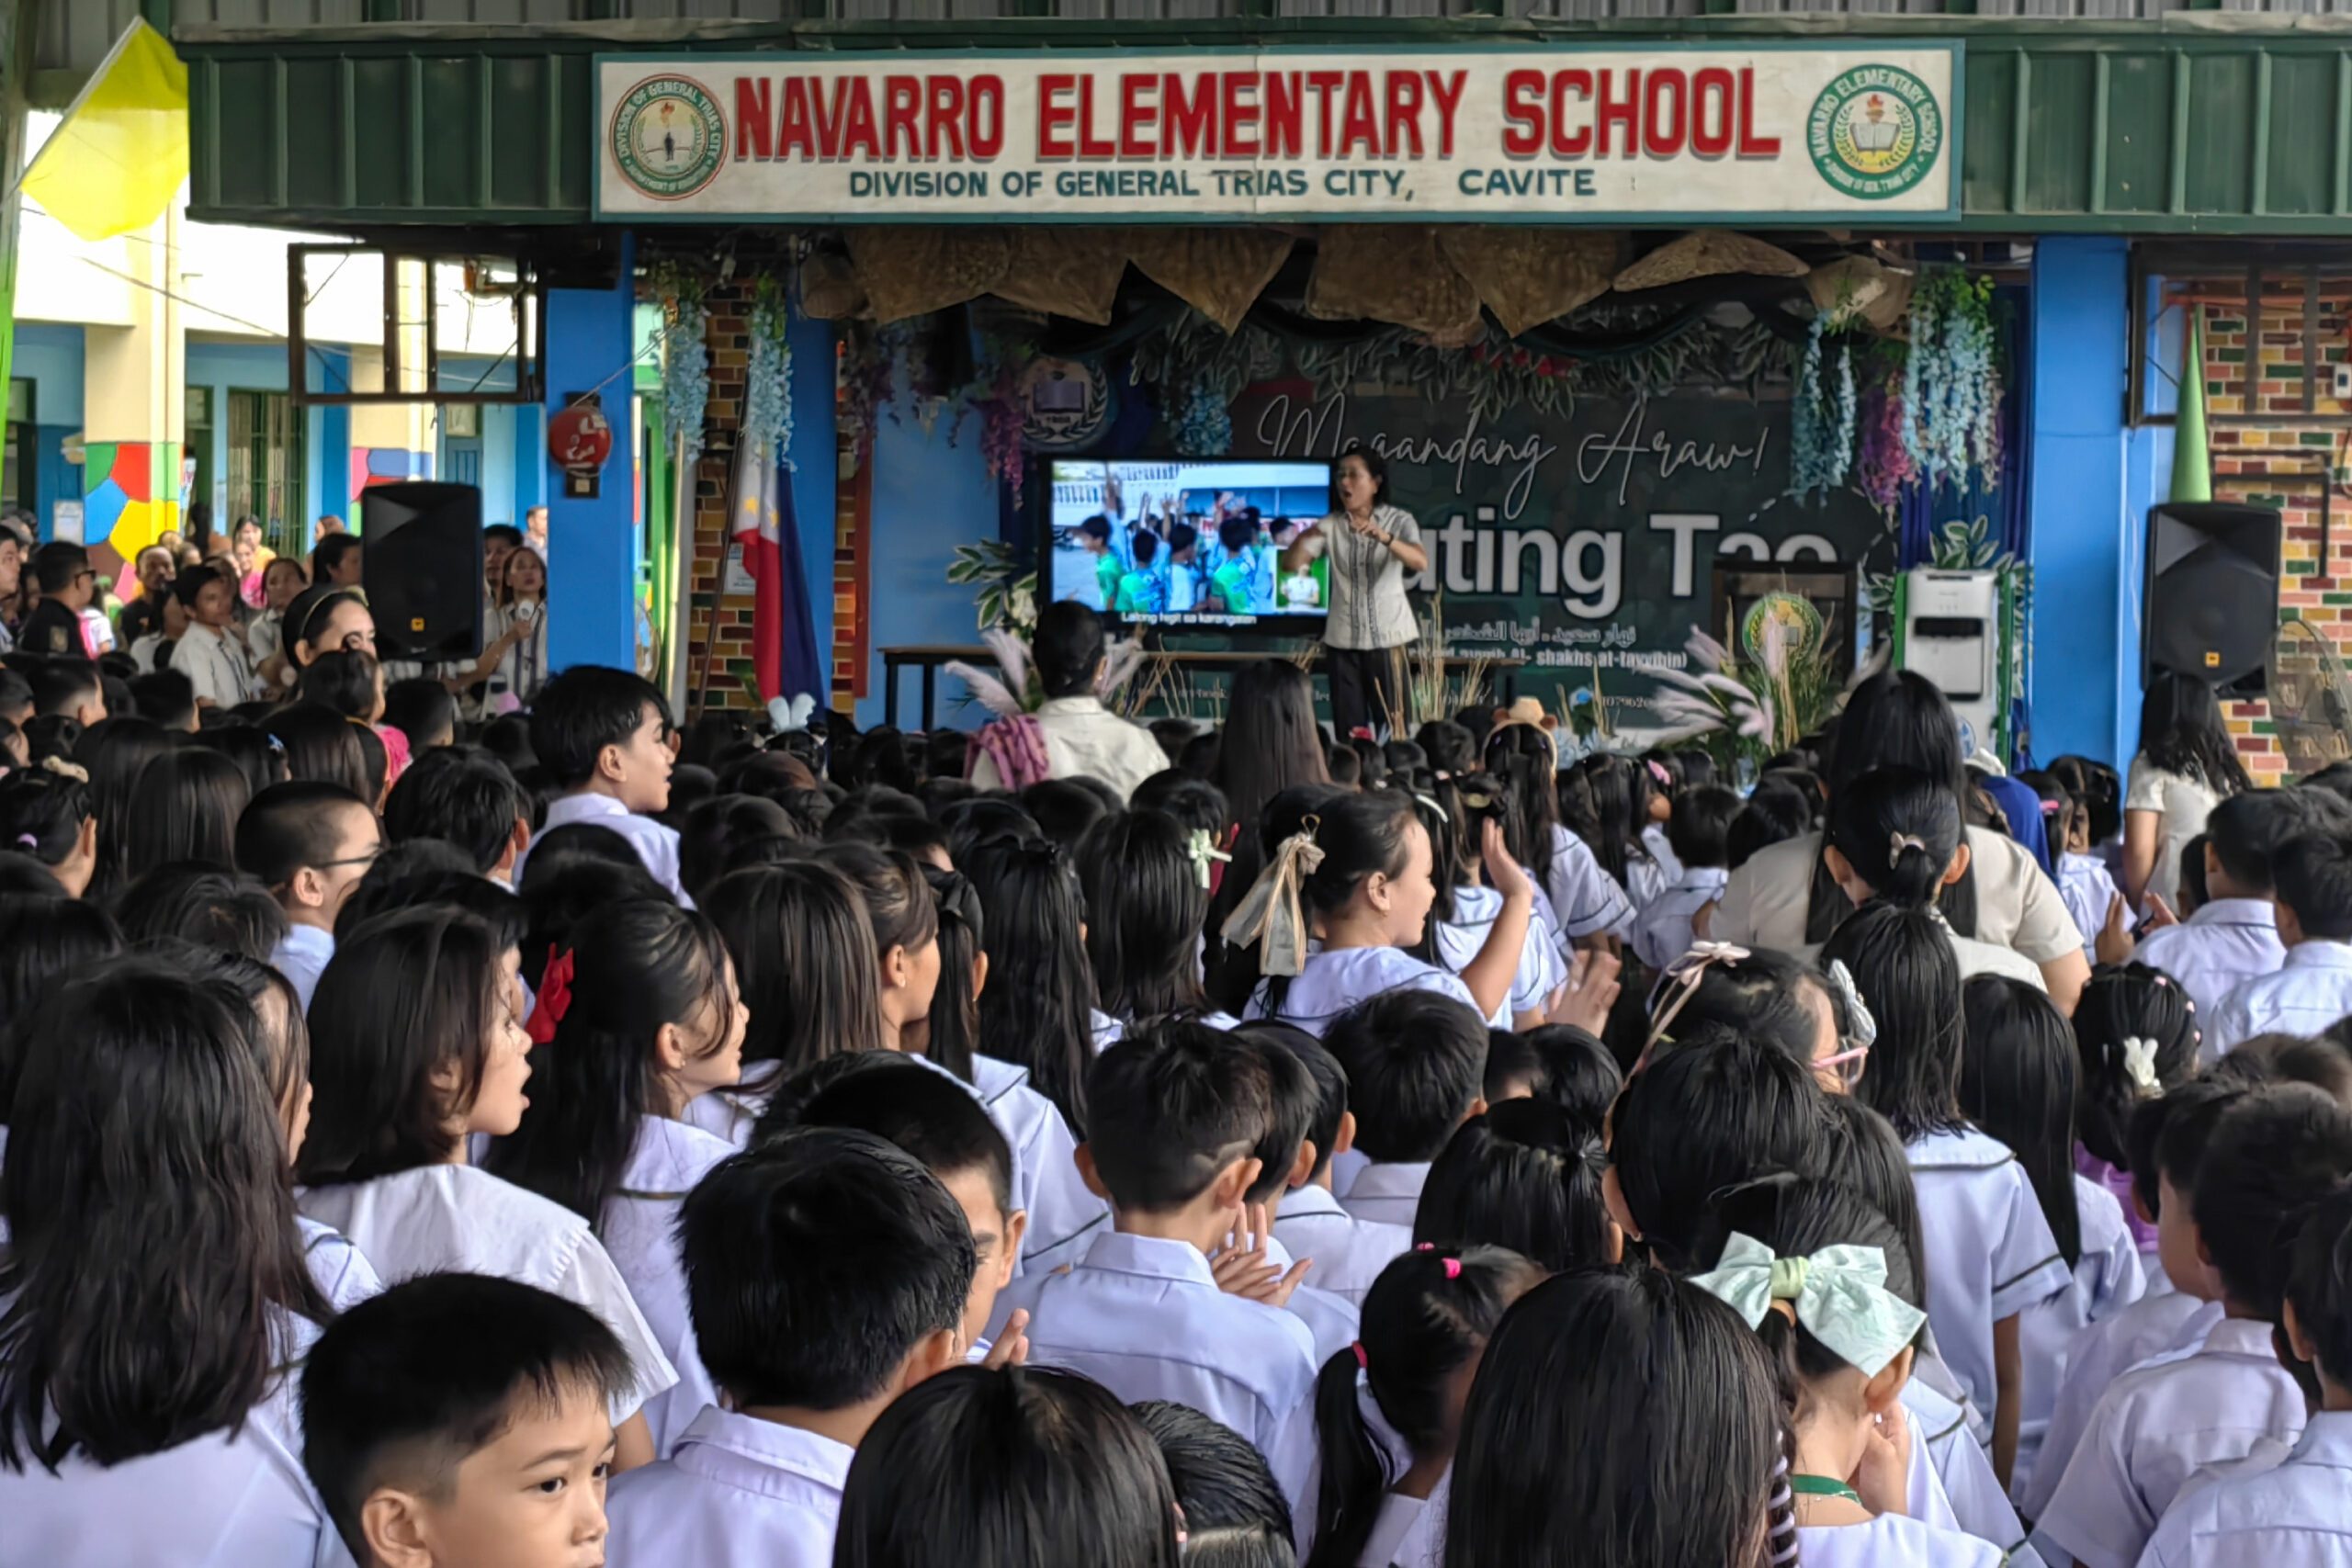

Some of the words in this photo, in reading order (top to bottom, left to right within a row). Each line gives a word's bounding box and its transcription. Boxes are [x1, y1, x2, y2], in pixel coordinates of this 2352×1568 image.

[633, 89, 647, 105] OF
[648, 81, 697, 102] GENERAL
[735, 73, 1003, 158] NAVARRO
[1037, 70, 1468, 157] ELEMENTARY
[1501, 67, 1780, 155] SCHOOL
[850, 171, 986, 197] DIVISION
[1001, 171, 1041, 197] OF
[1057, 170, 1198, 197] GENERAL
[1212, 169, 1307, 196] TRIAS
[1325, 169, 1412, 200] CITY,
[1459, 169, 1595, 196] CAVITE
[1578, 389, 1769, 507] Araw!
[1536, 650, 1594, 667] shakhs
